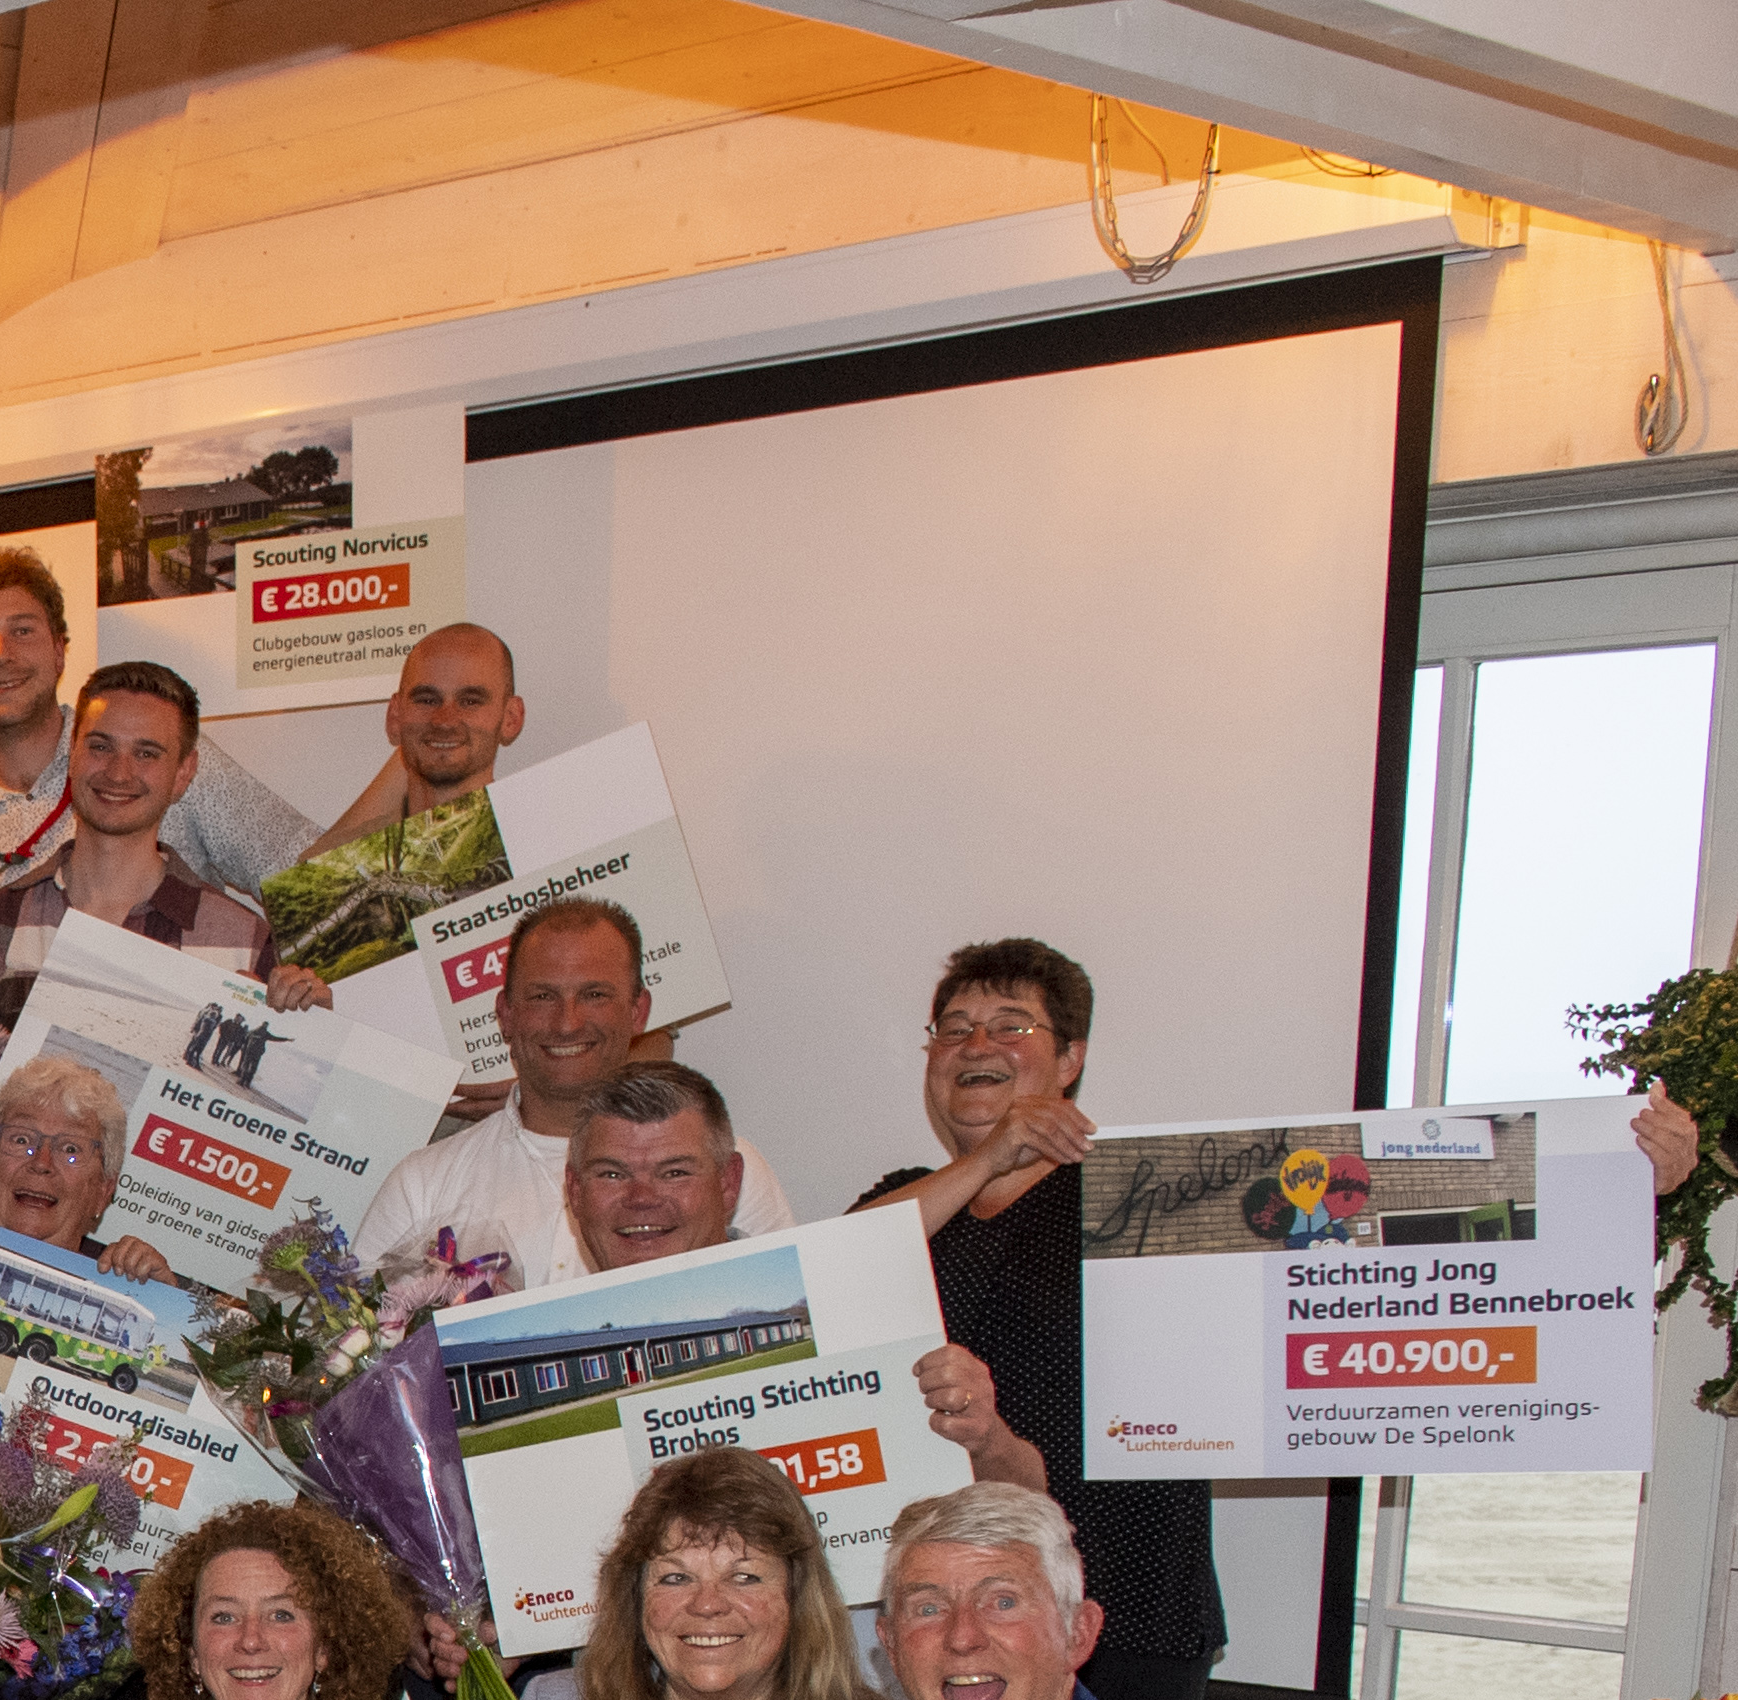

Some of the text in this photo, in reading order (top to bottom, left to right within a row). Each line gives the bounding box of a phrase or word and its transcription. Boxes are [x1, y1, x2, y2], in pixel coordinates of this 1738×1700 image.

[253, 532, 428, 568] Scouting Norvicus
[284, 576, 398, 610] 28.000,-
[253, 622, 427, 652] Clubgebouw gasloos en
[253, 646, 366, 671] energieneutraal
[433, 852, 631, 944] Staatsbosbeheer
[159, 1079, 369, 1176] Het Groene Strand
[1381, 1140, 1481, 1157] jong nederland
[177, 1136, 274, 1197] 1.500,-
[112, 1195, 202, 1238] voor groene
[119, 1174, 223, 1225] Opleiding van
[1286, 1258, 1497, 1288] Stichting Jong
[1287, 1287, 1634, 1321] Nederland Bennebroek
[1338, 1338, 1514, 1378] 40.900,-
[644, 1368, 882, 1433] Scouting Stichting
[1287, 1398, 1600, 1422] Verduurzamen verenigings-
[32, 1375, 239, 1463] Outdoor4disabled
[1121, 1421, 1177, 1436] Eneco
[1126, 1437, 1234, 1452] Luchterduinen
[1287, 1423, 1515, 1450] gebouw De Spelonk
[525, 1587, 574, 1607] Eneco
